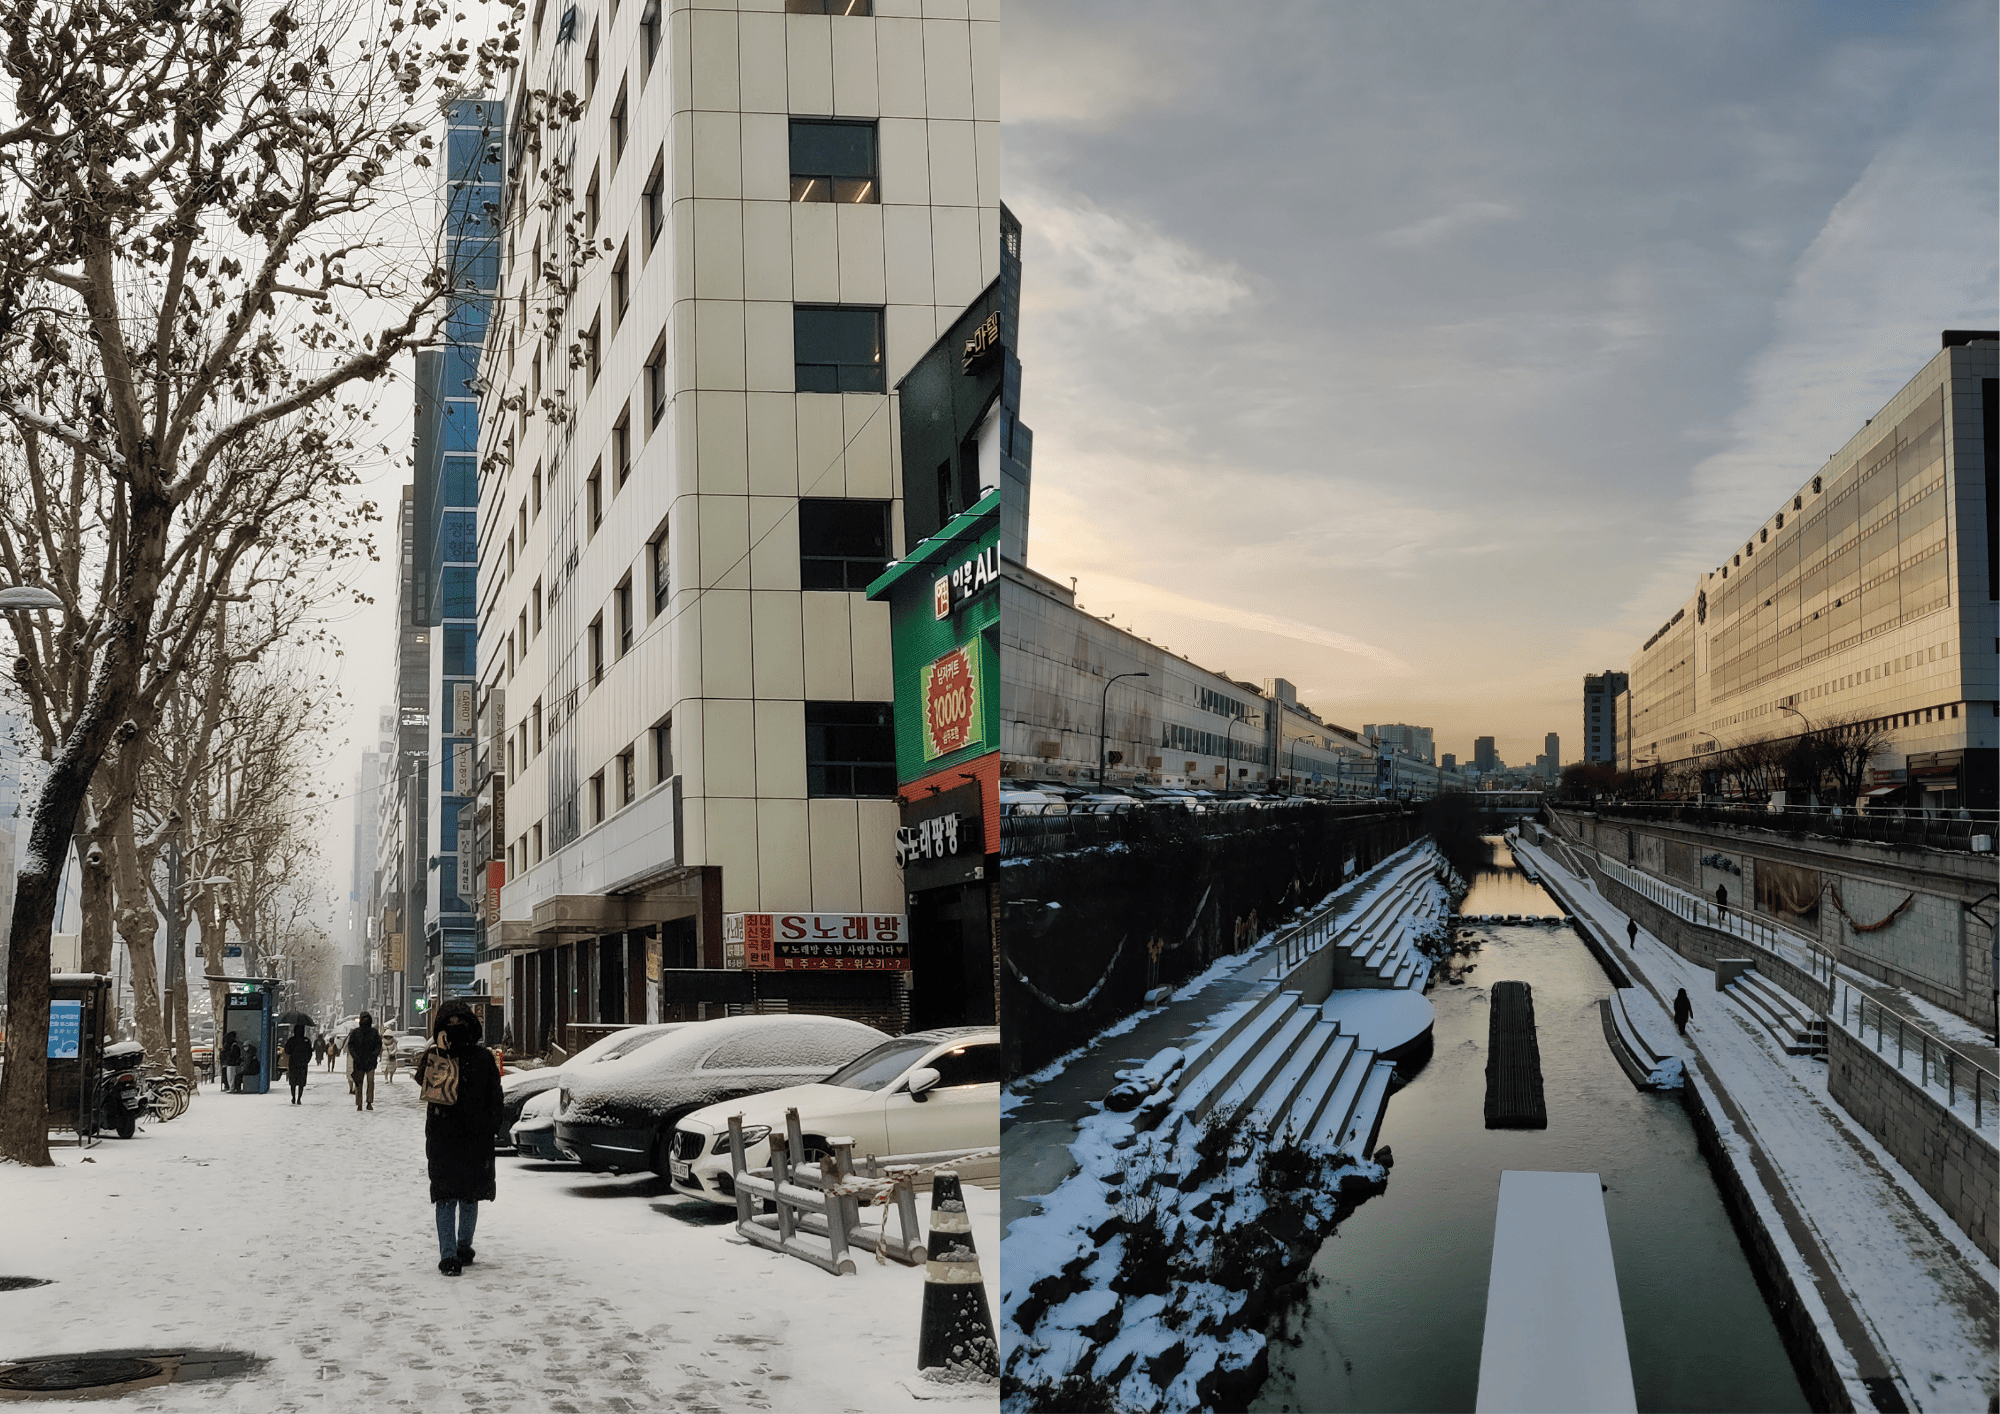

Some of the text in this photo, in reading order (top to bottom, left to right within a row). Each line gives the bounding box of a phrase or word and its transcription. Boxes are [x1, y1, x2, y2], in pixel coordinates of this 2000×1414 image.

[953, 540, 1000, 598] 이훈 AL
[937, 659, 960, 686] 남자커트
[462, 690, 470, 723] CARROT
[934, 685, 966, 730] 10000
[459, 746, 467, 787] 당근영어
[781, 916, 900, 941] S노래방
[791, 944, 894, 955] 노래방 손님 사랑합니다
